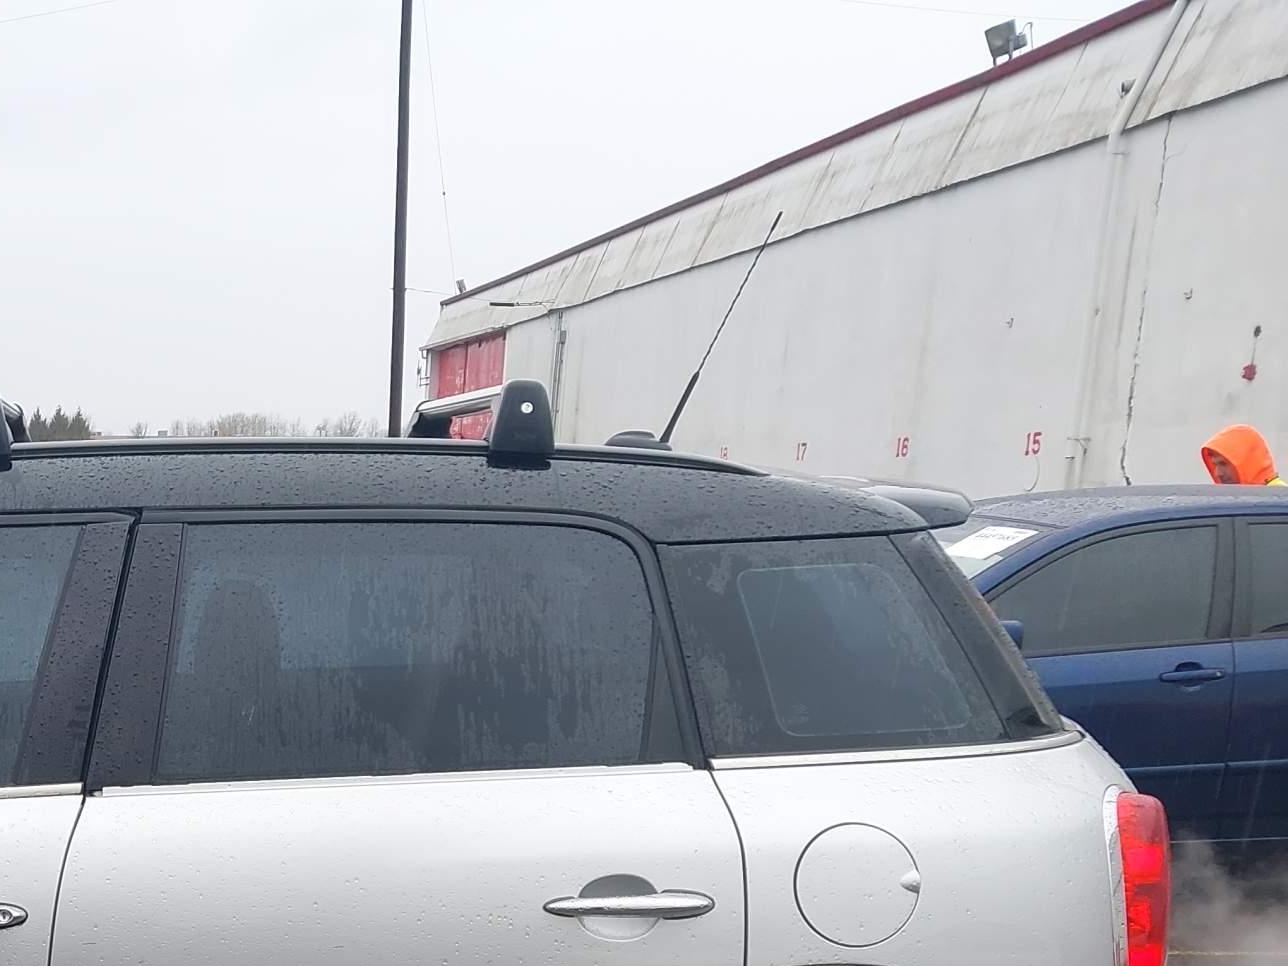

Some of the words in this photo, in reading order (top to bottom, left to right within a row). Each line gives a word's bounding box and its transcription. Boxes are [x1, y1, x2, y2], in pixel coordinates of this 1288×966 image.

[796, 442, 808, 461] 17
[896, 437, 909, 457] 16
[1024, 432, 1042, 456] 15
